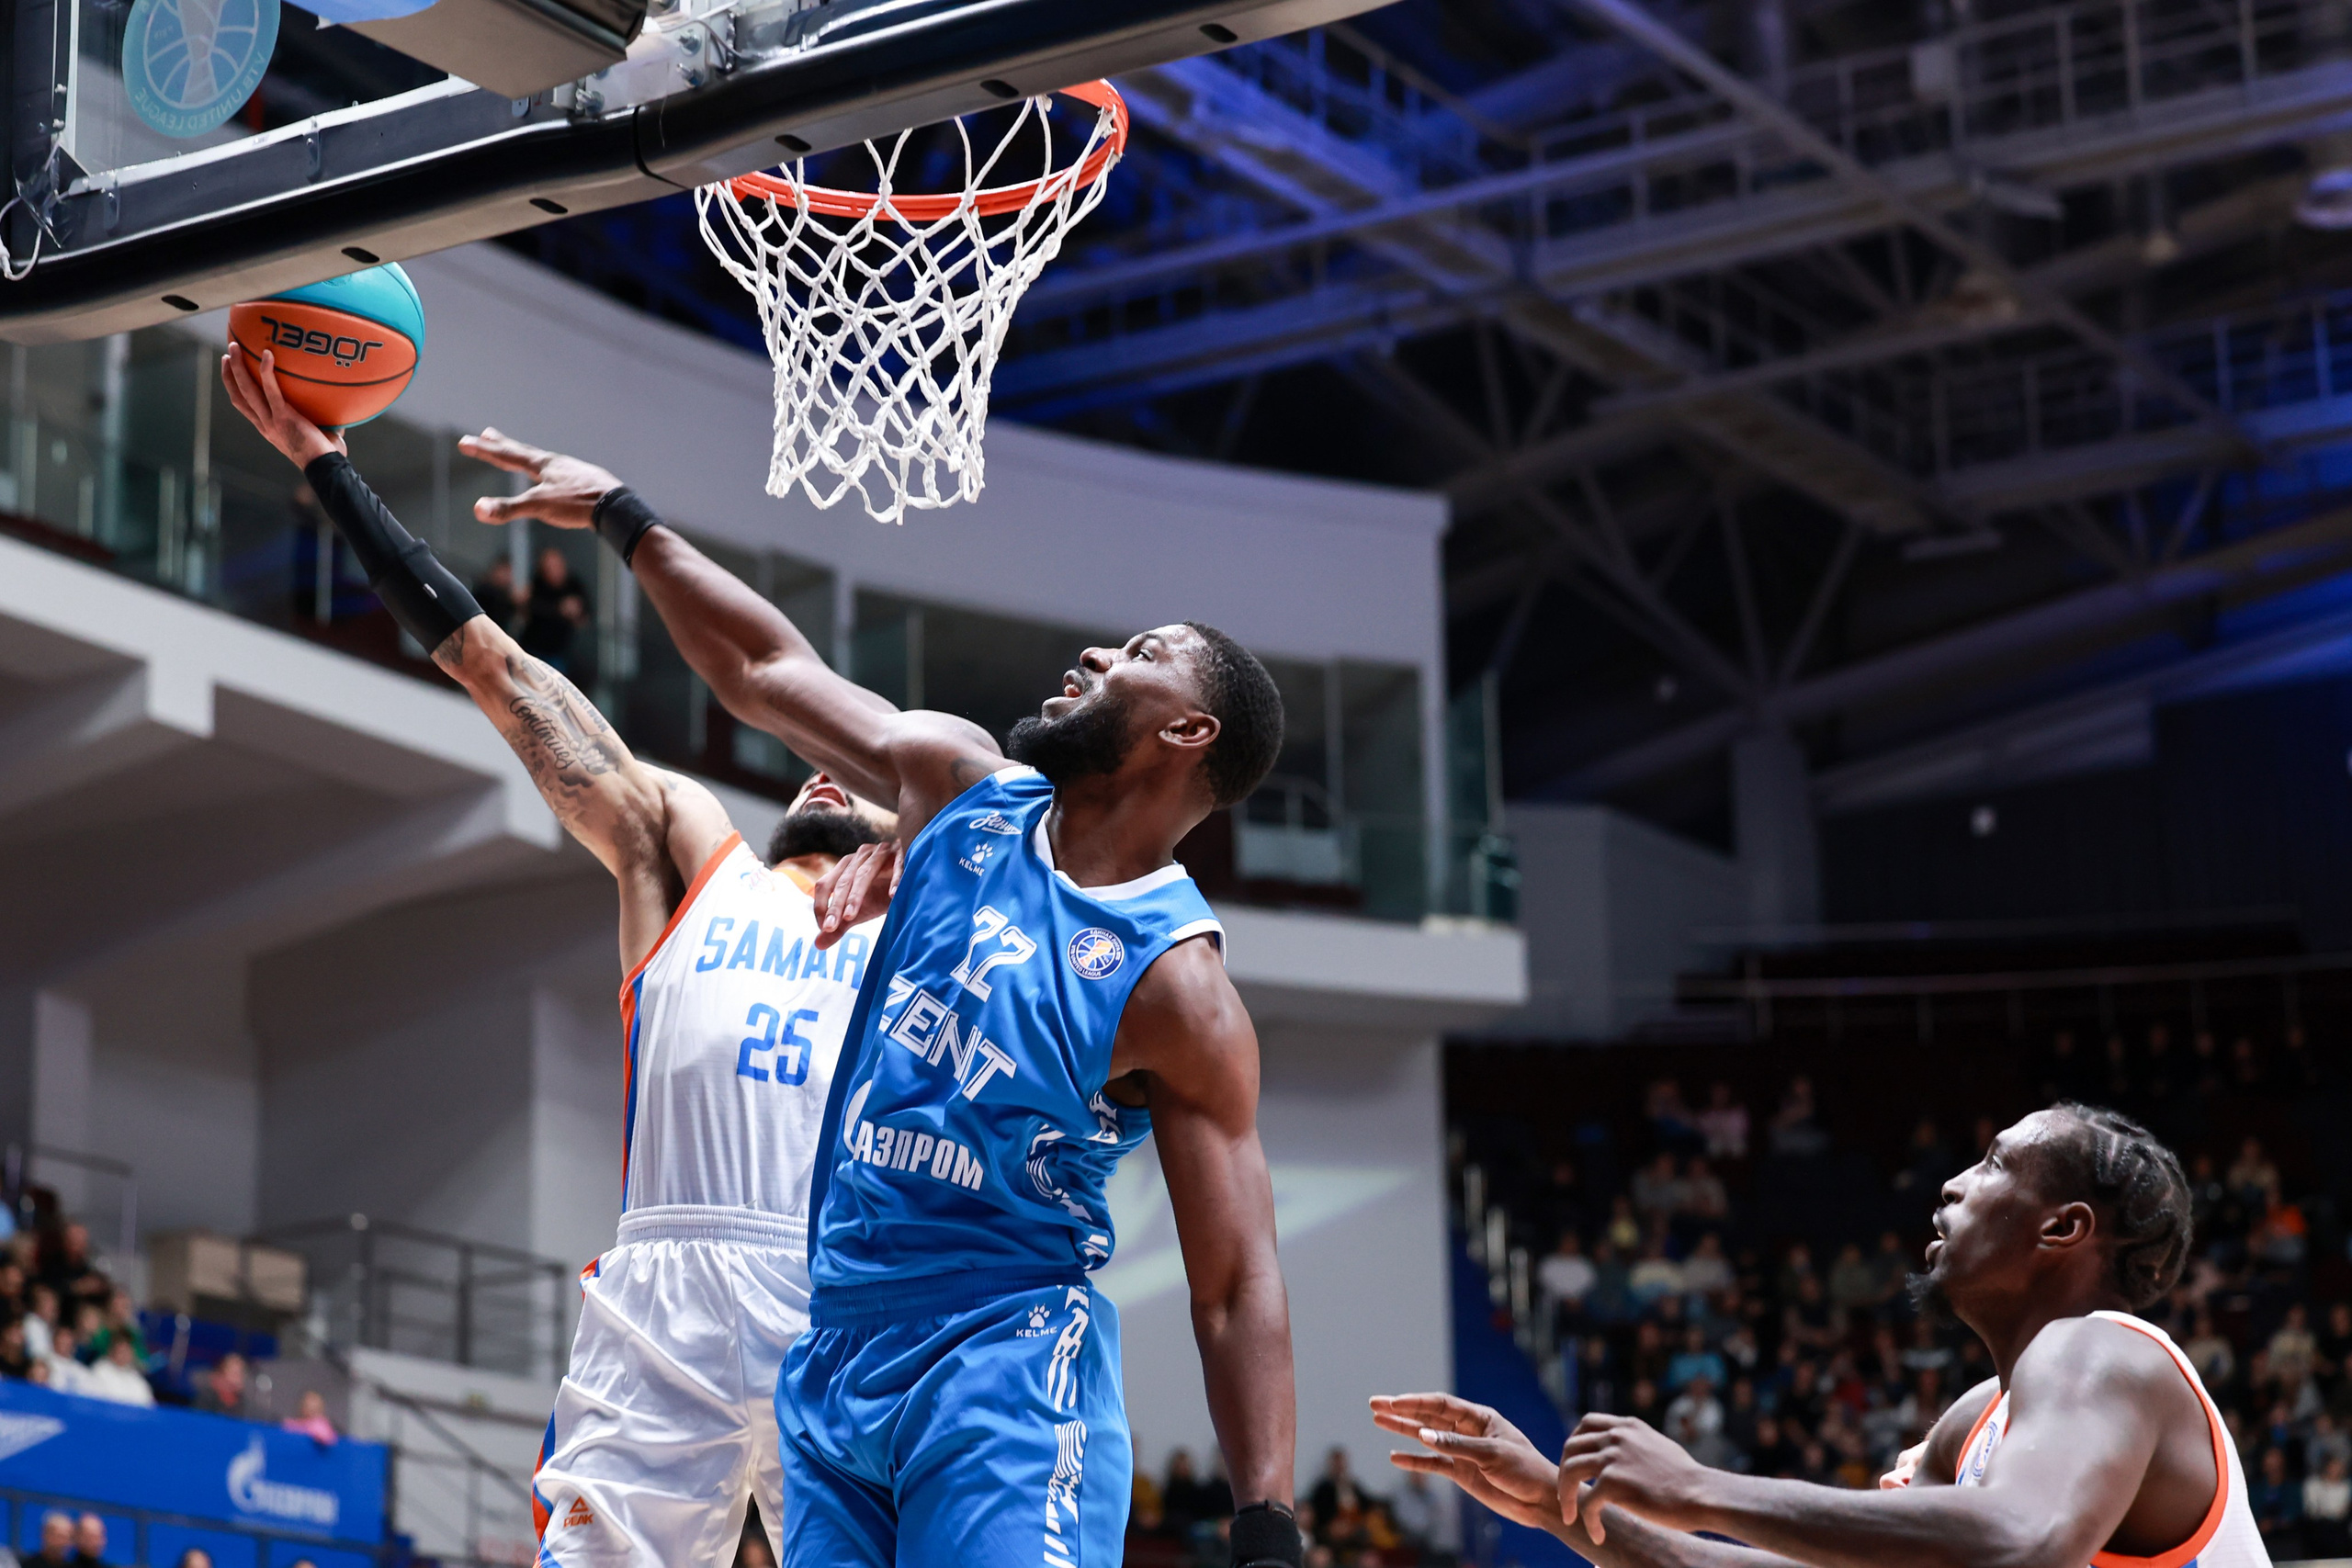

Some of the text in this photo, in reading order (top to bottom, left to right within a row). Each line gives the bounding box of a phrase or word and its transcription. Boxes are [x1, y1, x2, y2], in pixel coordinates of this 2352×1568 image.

[260, 314, 384, 368] JÖGEL
[958, 856, 985, 877] KELME
[695, 916, 869, 990] SAMAR
[949, 905, 1037, 1003] 22
[736, 1002, 819, 1087] 25
[877, 974, 1017, 1101] ZENT
[1016, 1325, 1057, 1337] KELME
[563, 1513, 594, 1529] PEAK
